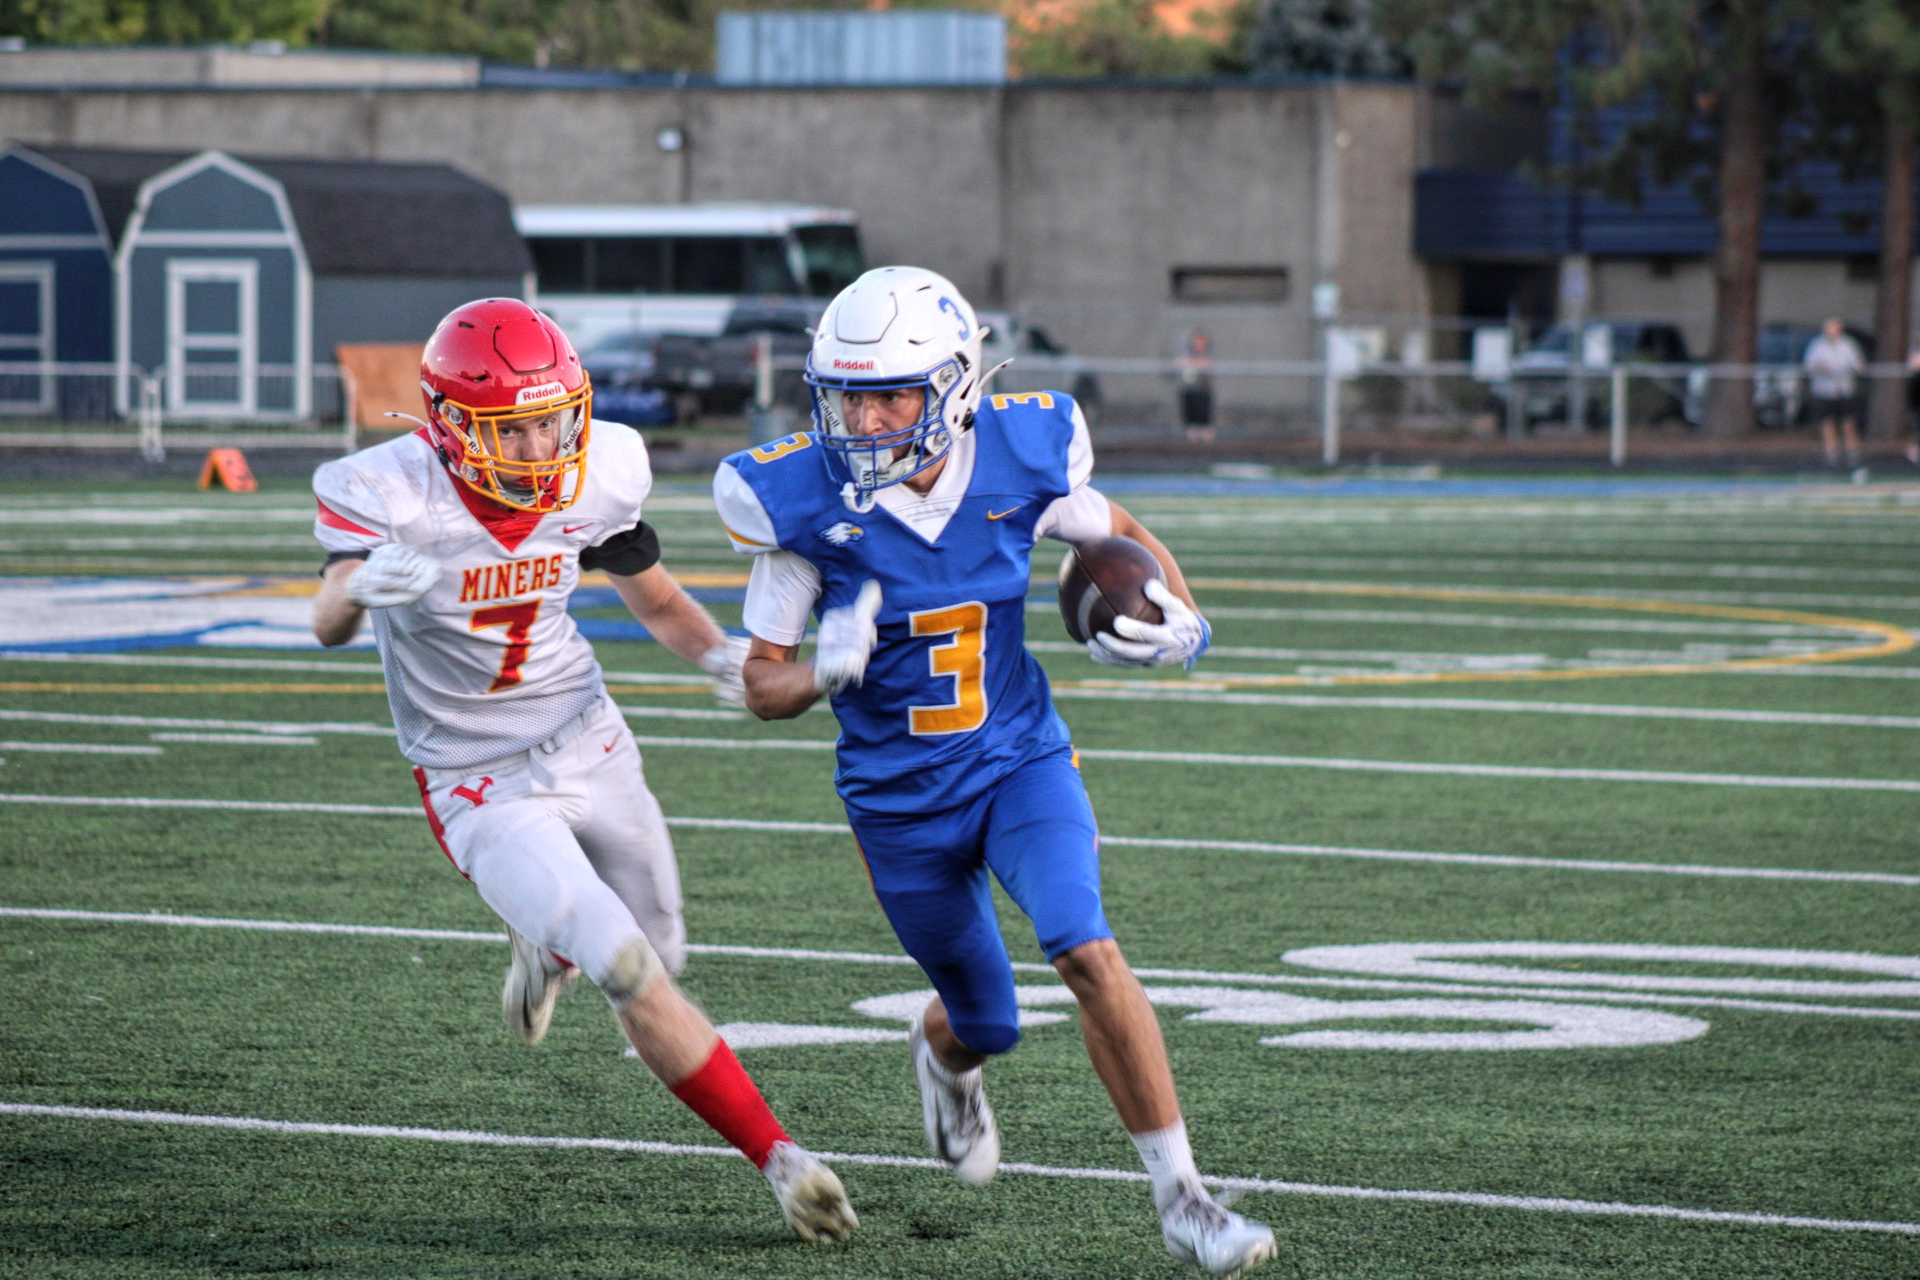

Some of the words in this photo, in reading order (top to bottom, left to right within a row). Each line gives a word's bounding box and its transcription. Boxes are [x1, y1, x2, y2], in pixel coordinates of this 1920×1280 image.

[937, 296, 970, 342] 3
[833, 359, 875, 371] Riddell
[523, 385, 561, 401] Riddell
[990, 391, 1055, 410] 3
[562, 418, 583, 451] Riddell
[747, 431, 813, 464] 3
[458, 553, 563, 603] MINERS
[468, 597, 543, 694] 7
[908, 600, 988, 736] 3
